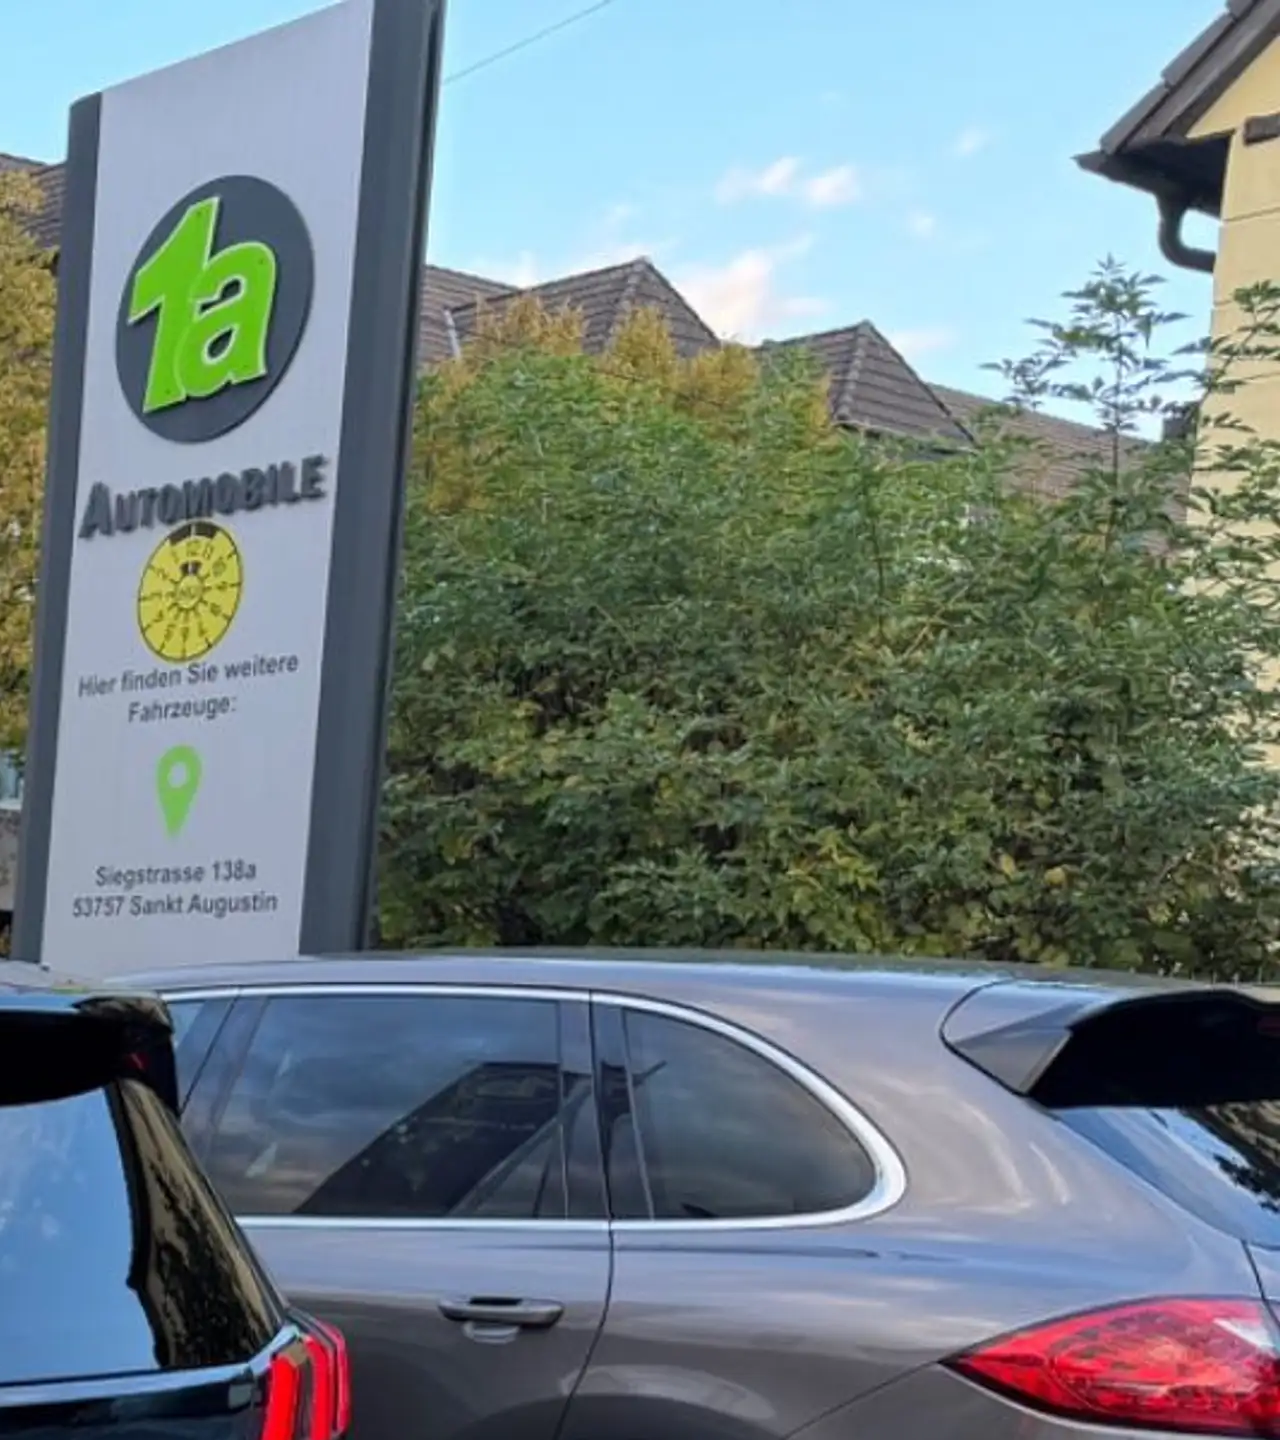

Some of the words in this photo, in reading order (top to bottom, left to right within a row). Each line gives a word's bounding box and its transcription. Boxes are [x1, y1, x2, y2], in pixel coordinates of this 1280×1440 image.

[127, 196, 276, 413] 1a
[77, 675, 117, 698] Hier
[121, 668, 182, 692] finden
[188, 662, 219, 685] Sie
[224, 654, 299, 681] weitere
[128, 696, 238, 723] Fahrzeuge:
[95, 865, 205, 890] Siegstrasse
[213, 859, 257, 881] 138a
[72, 894, 126, 917] 53757
[130, 894, 184, 916] Sankt
[187, 890, 279, 918] Augustin
